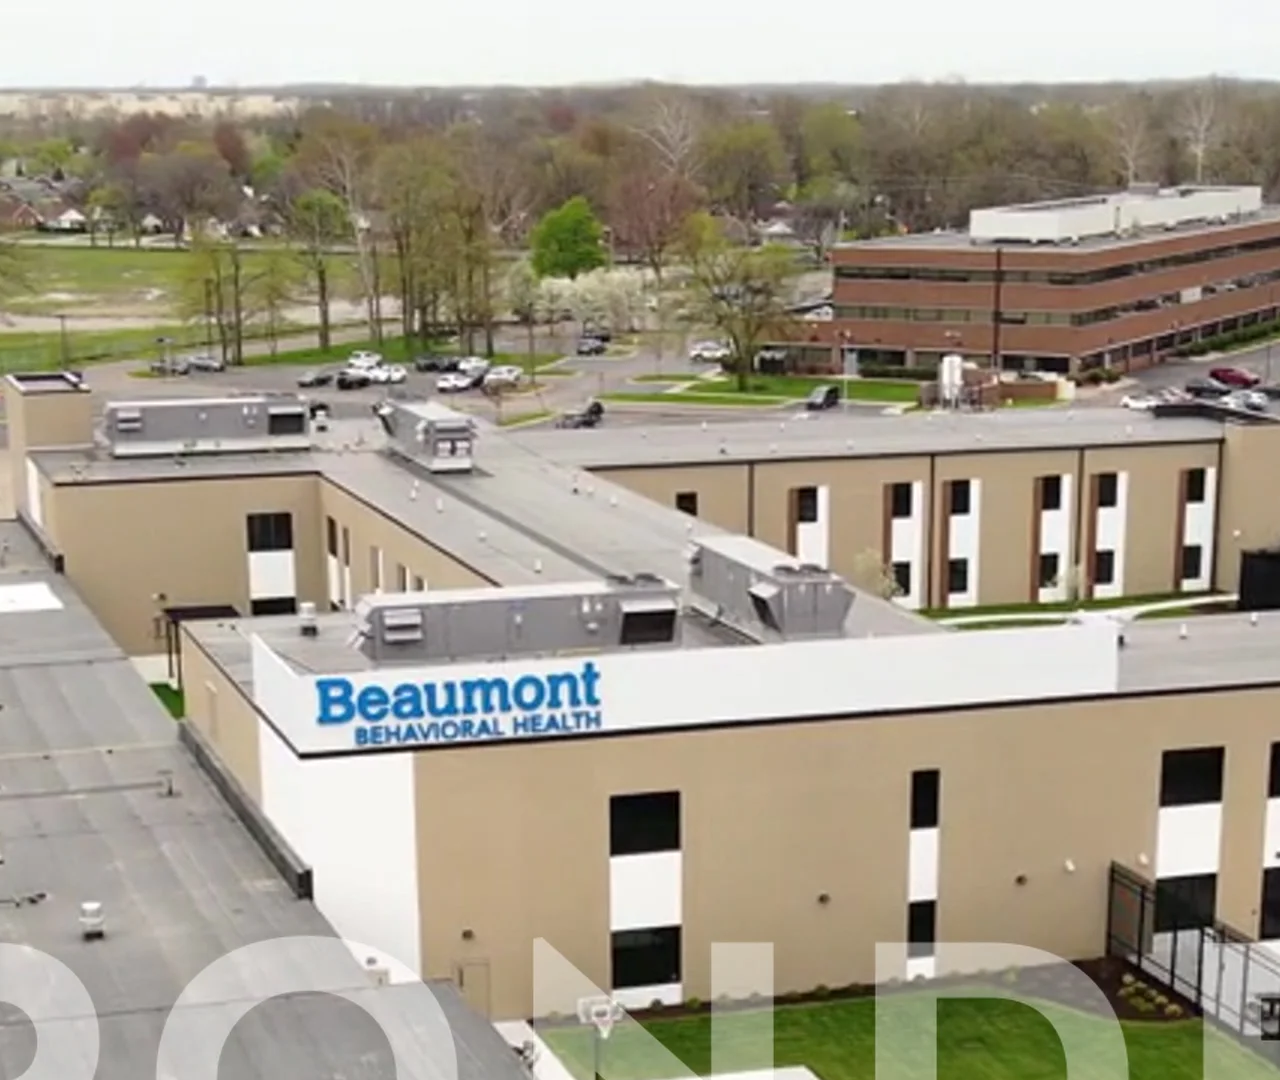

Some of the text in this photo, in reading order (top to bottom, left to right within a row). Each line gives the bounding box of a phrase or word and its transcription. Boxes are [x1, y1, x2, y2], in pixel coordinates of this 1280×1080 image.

[316, 662, 600, 725] Beaumont
[356, 712, 601, 746] BEHAVIORAL HEALTH
